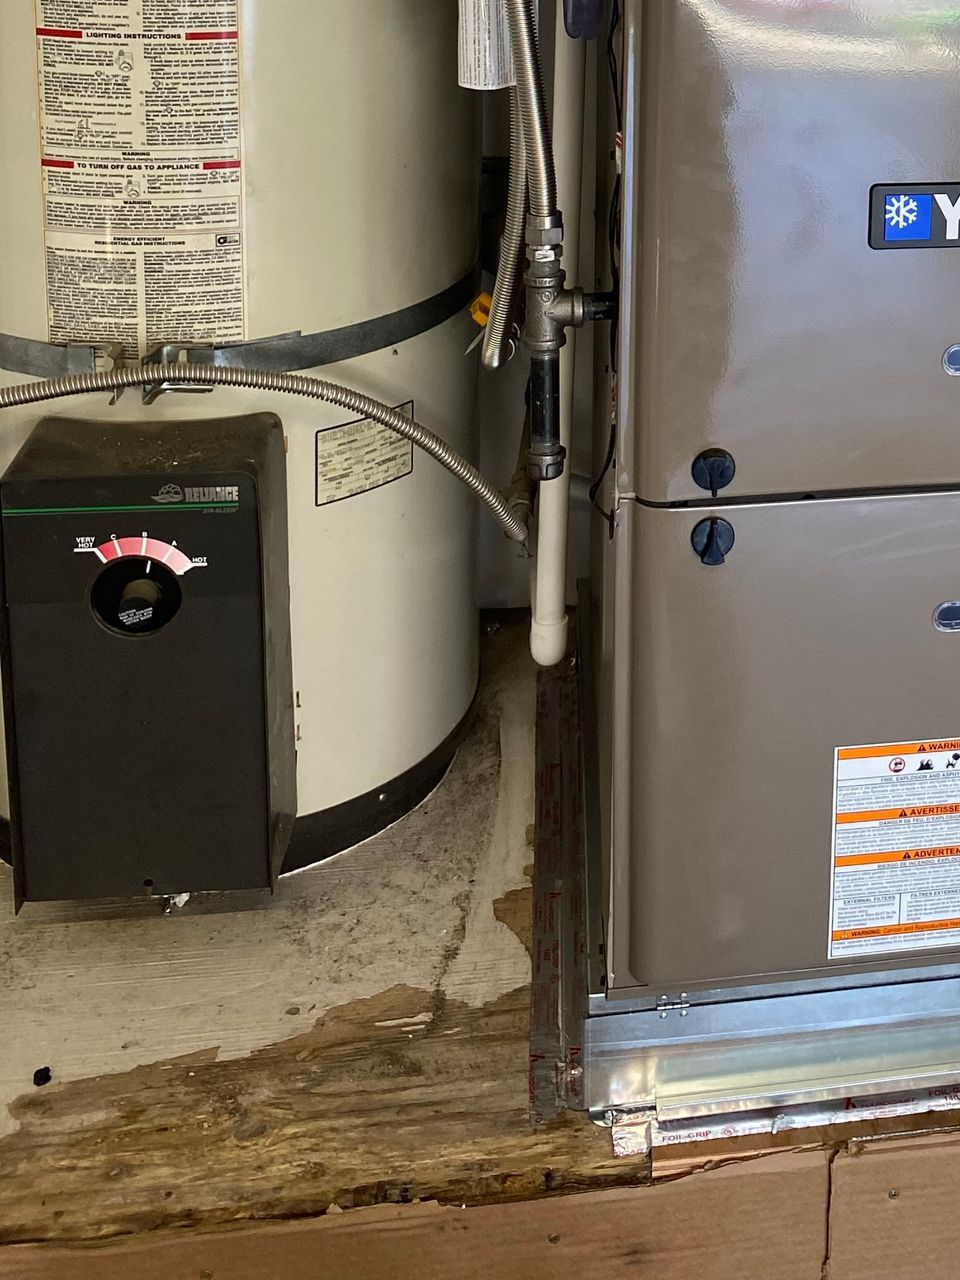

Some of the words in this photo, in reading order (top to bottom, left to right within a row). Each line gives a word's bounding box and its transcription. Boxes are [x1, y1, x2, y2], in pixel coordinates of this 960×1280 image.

[184, 486, 239, 502] RELIANCE
[896, 773, 928, 782] EXPLOSION
[843, 897, 872, 906] EXTERNAL
[661, 1130, 712, 1143] FOIL-GRIP
